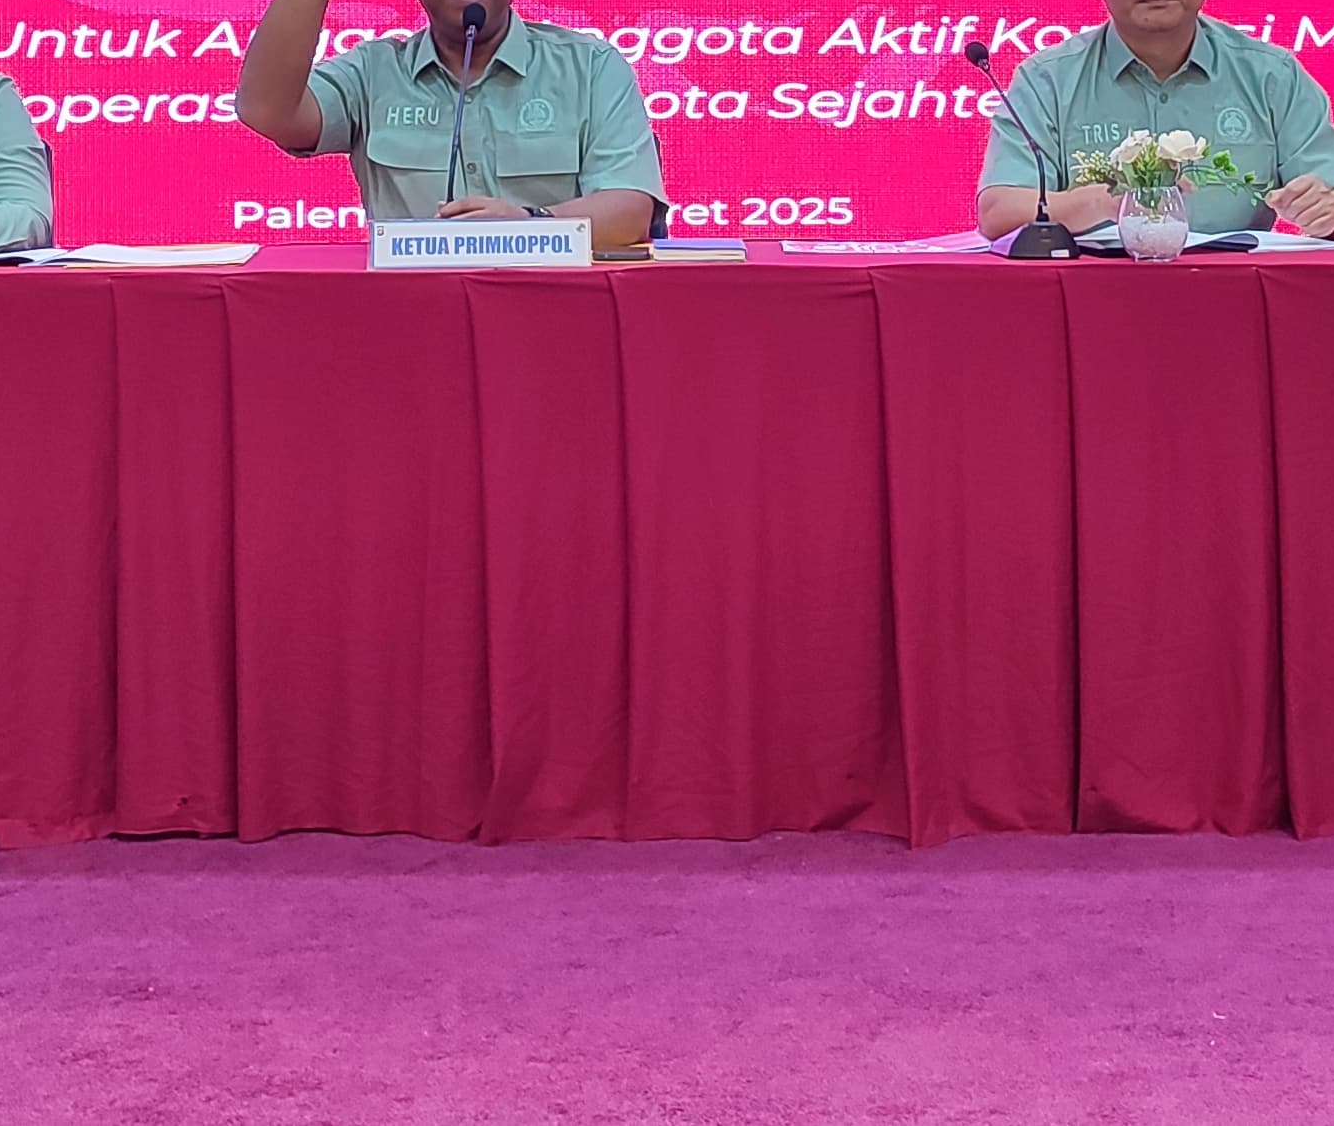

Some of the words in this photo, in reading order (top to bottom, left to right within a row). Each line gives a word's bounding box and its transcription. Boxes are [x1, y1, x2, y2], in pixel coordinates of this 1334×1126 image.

[543, 20, 804, 65] ggota
[818, 15, 980, 55] Aktif
[22, 92, 239, 133] operas
[386, 105, 440, 126] HERU
[767, 80, 1008, 129] Sejahte
[1081, 122, 1121, 145] TRIS
[666, 199, 729, 226] ret
[741, 197, 854, 226] 2025
[391, 236, 450, 256] KETUA
[454, 234, 573, 254] PRIMKOPPOL
